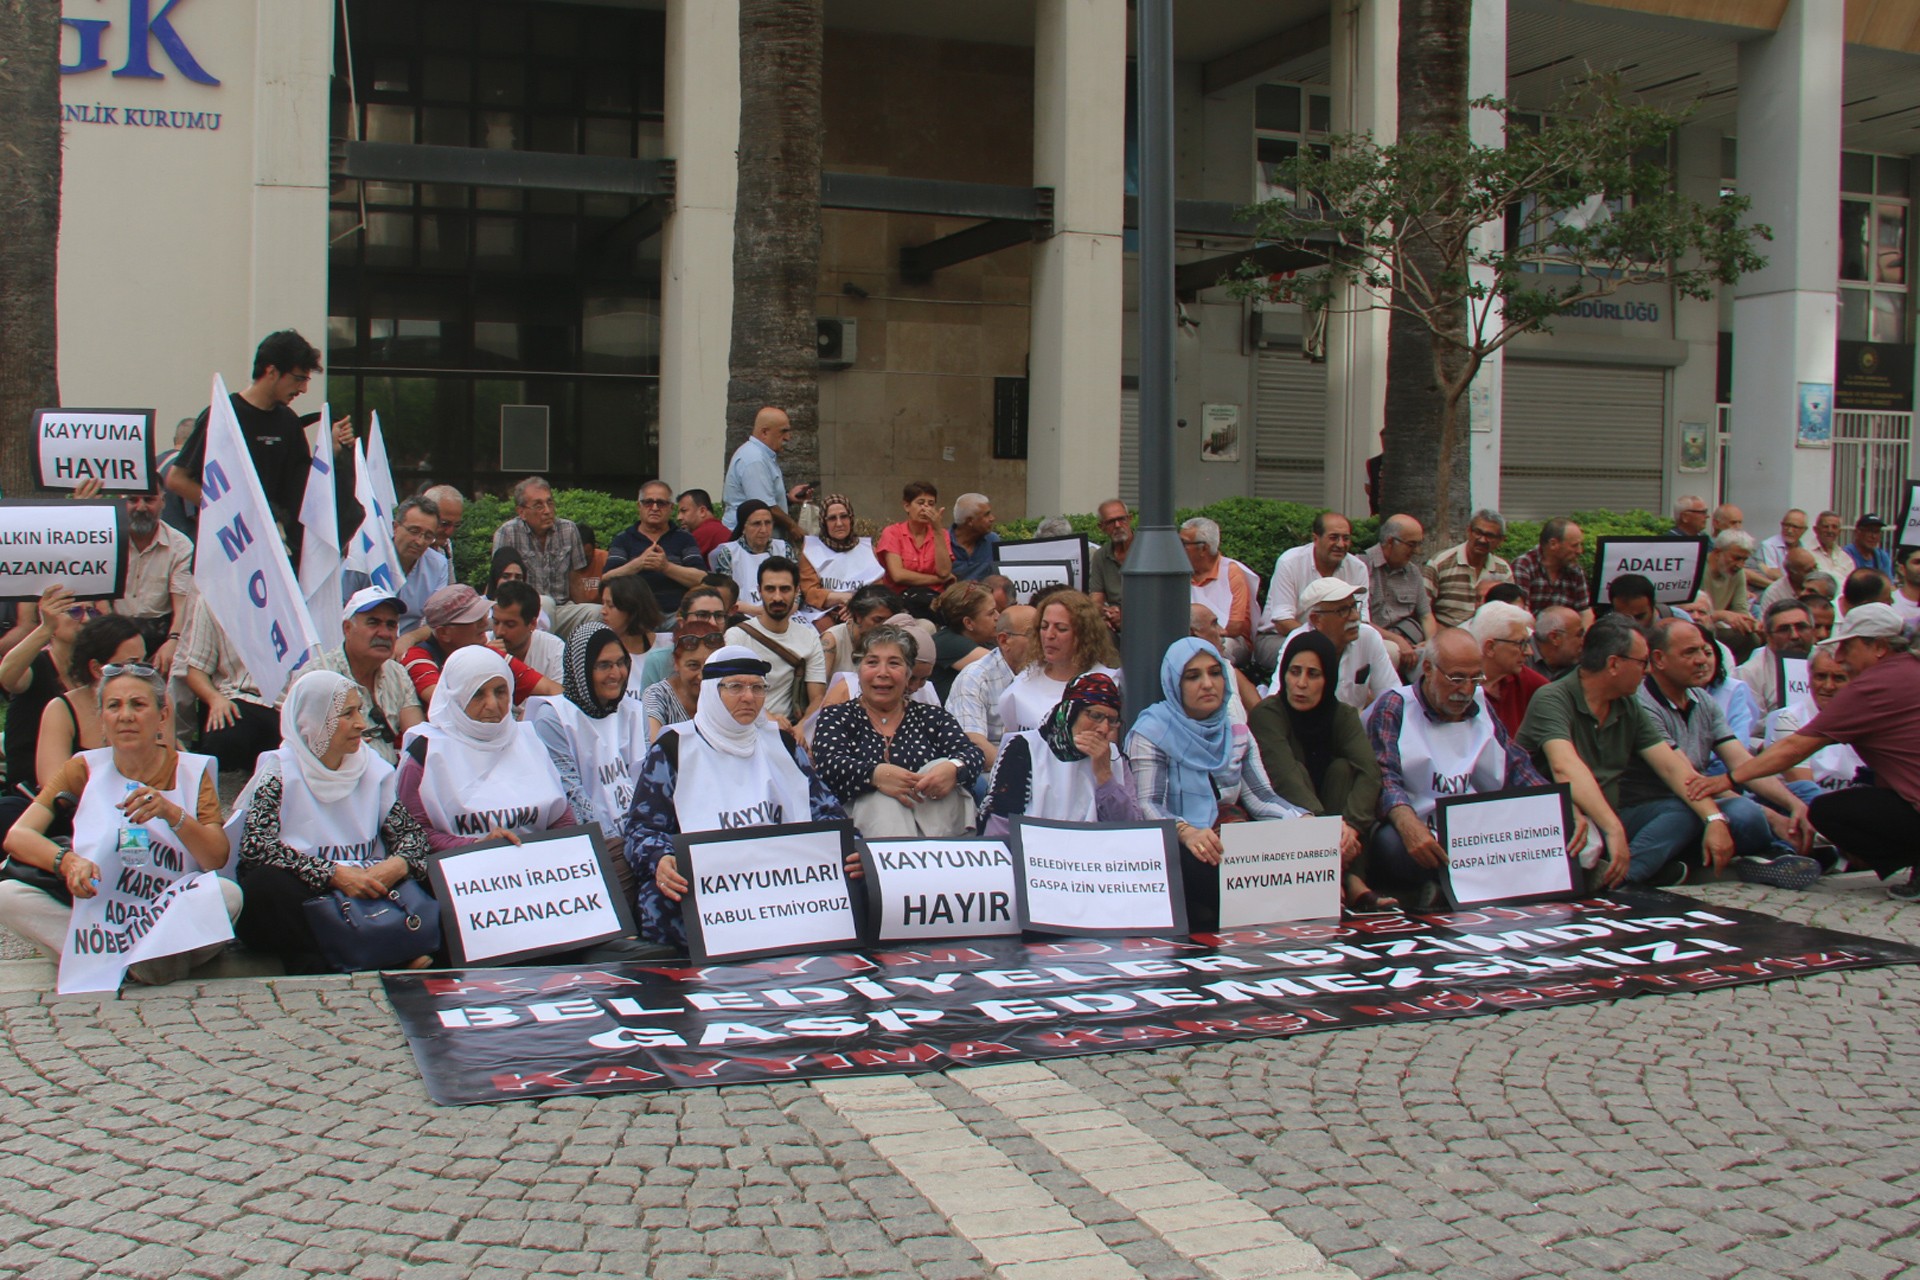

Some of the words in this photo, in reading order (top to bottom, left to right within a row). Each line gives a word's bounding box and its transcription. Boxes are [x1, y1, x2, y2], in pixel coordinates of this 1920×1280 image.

[61, 102, 118, 125] NLİK
[124, 107, 222, 130] KURUMU
[44, 422, 142, 441] KAYYUMA
[55, 457, 137, 480] HAYIR
[47, 528, 113, 544] İRADESİ
[1617, 558, 1684, 571] ADALET
[455, 806, 540, 835] KAYYUMA
[1451, 831, 1512, 847] BELEDİYELER
[1514, 824, 1560, 840] BİZİMDİR
[878, 849, 1012, 871] KAYYUMA
[1029, 857, 1102, 872] BELEDİYELER
[1105, 858, 1162, 873] BİZİMDİR
[1224, 853, 1260, 865] KAYYUM
[1261, 851, 1296, 862] İRADEYE
[1297, 848, 1338, 860] DARBEDİR
[1451, 856, 1485, 869] GASPA
[1486, 852, 1506, 865] İZİN
[1508, 846, 1564, 862] VERİLEMEZ
[454, 873, 522, 897] HALKIN
[525, 859, 597, 886] İRADESİ
[701, 863, 839, 895] KAYYUMLARI
[1030, 878, 1068, 892] GASPA
[1071, 881, 1095, 893] İZİN
[1097, 881, 1166, 893] VERİLEMEZ
[1226, 872, 1293, 890] KAYYUMA
[1296, 869, 1336, 884] HAYIR
[469, 893, 602, 931] KAZANACAK
[703, 908, 756, 926] KABUL
[759, 897, 849, 919] ETMİYORUZ
[903, 891, 1011, 926] HAYIR
[436, 953, 1263, 1029] BELEDİYELER
[1262, 909, 1739, 967] BİZİMDİR!
[587, 1007, 946, 1050] GASP
[491, 1038, 1021, 1093] KAYYIMA
